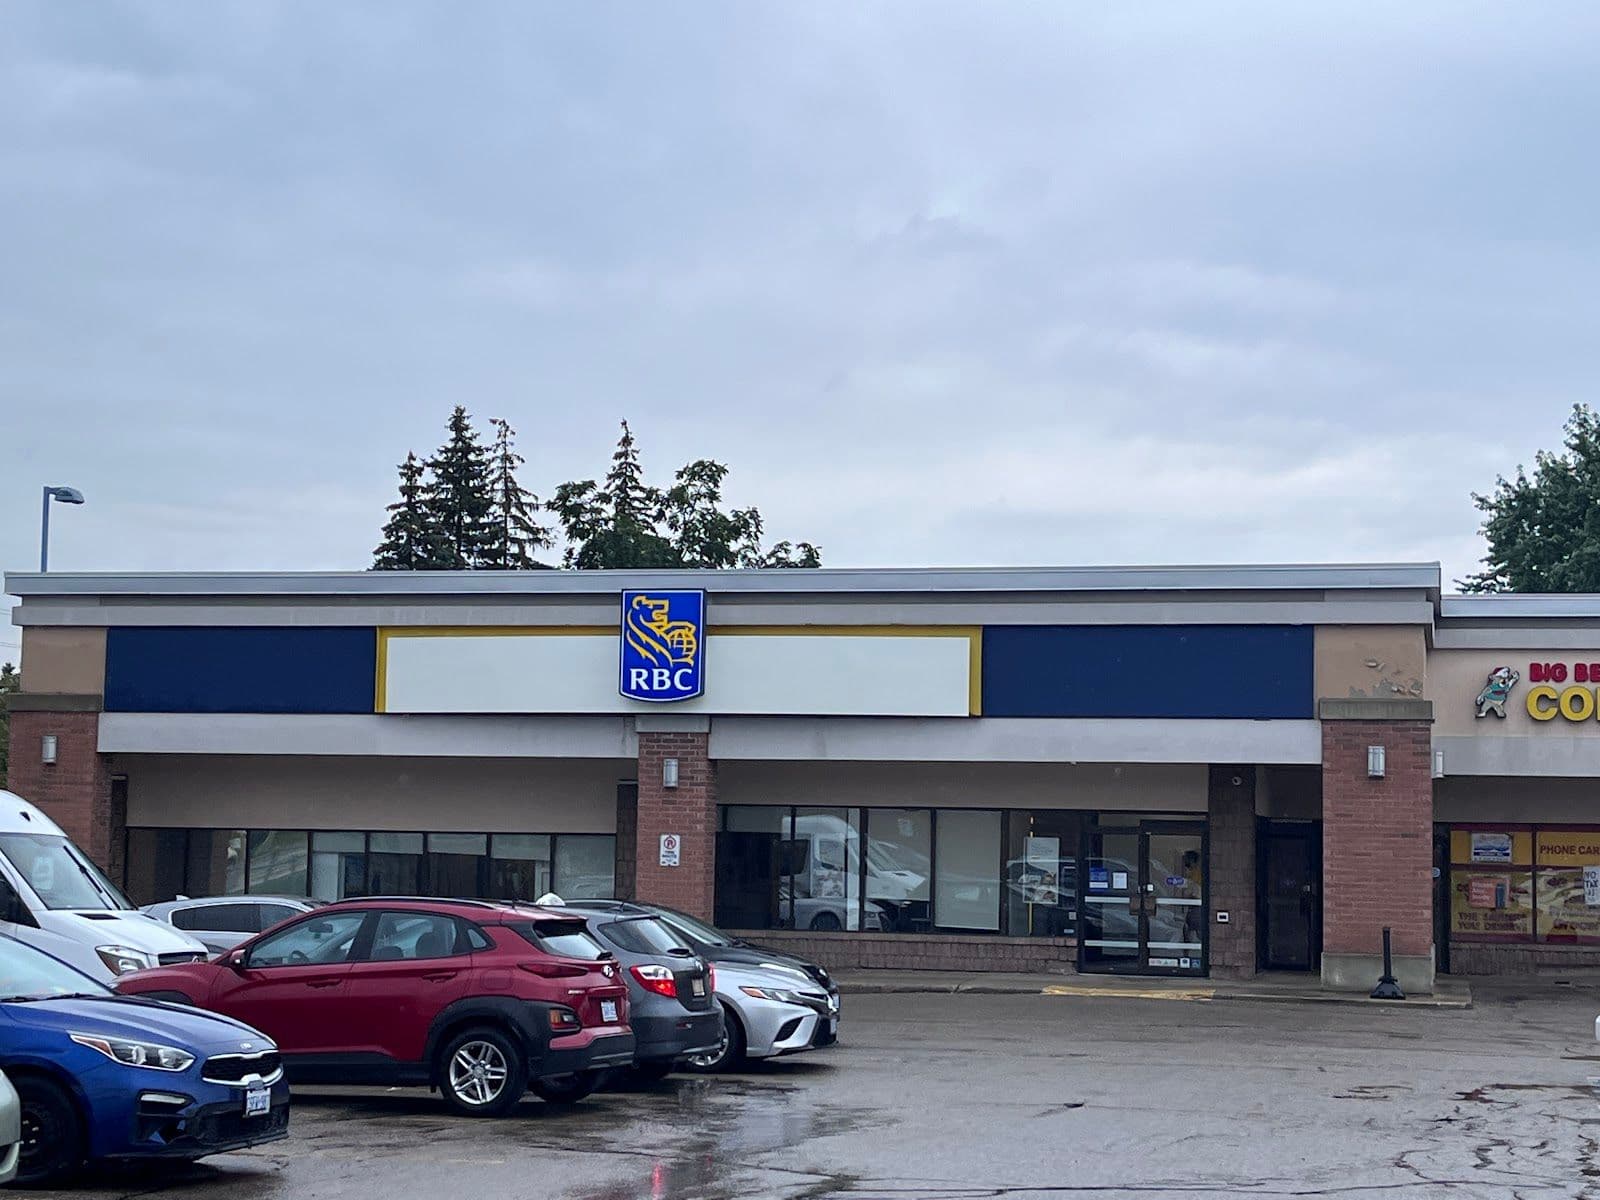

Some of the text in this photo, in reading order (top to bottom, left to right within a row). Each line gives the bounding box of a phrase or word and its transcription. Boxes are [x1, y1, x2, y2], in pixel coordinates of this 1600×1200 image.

[630, 668, 693, 691] RBC
[1529, 662, 1568, 683] BIG
[1526, 685, 1600, 722] CO
[1540, 845, 1577, 855] PHONE
